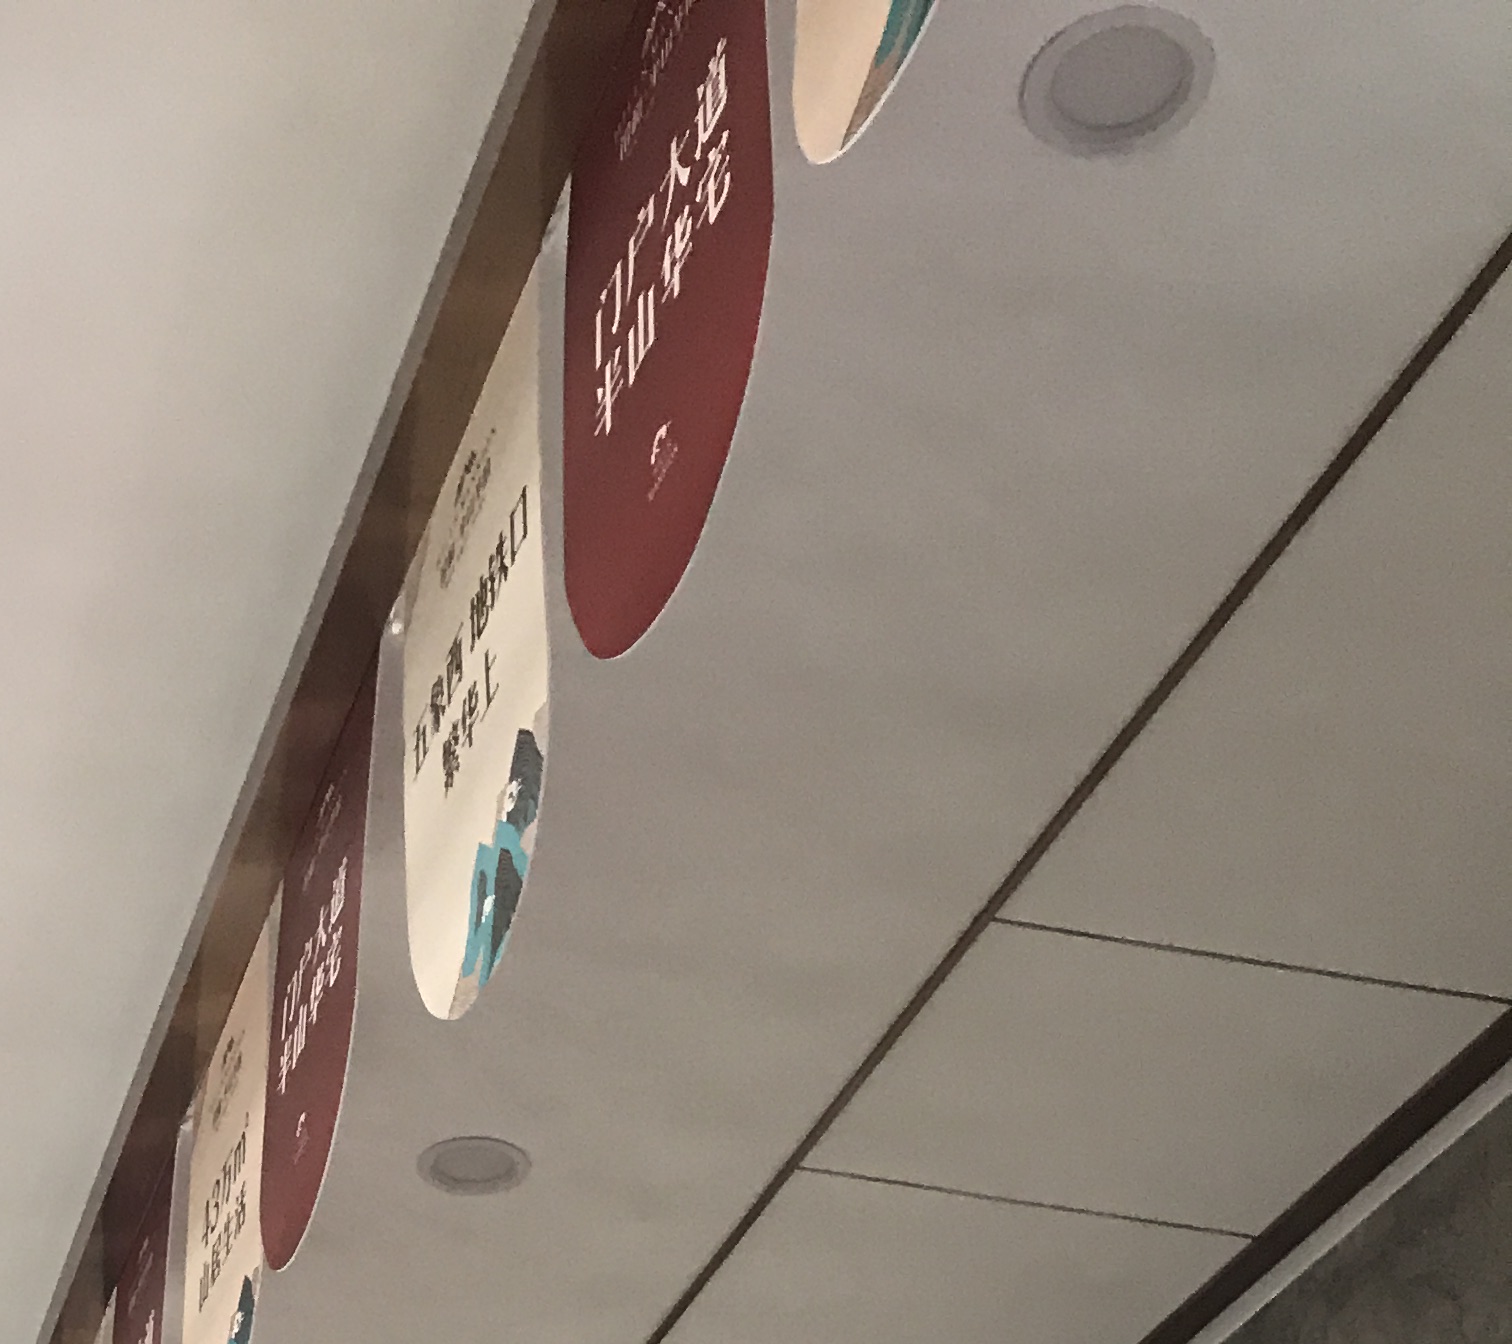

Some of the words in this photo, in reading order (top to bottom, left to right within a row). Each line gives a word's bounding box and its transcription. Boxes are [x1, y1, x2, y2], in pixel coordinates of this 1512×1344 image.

[594, 130, 731, 437] 半山华宅
[595, 37, 727, 371] 门户大道
[277, 925, 343, 1095] 半山华宅
[281, 856, 348, 1042] 门户大道
